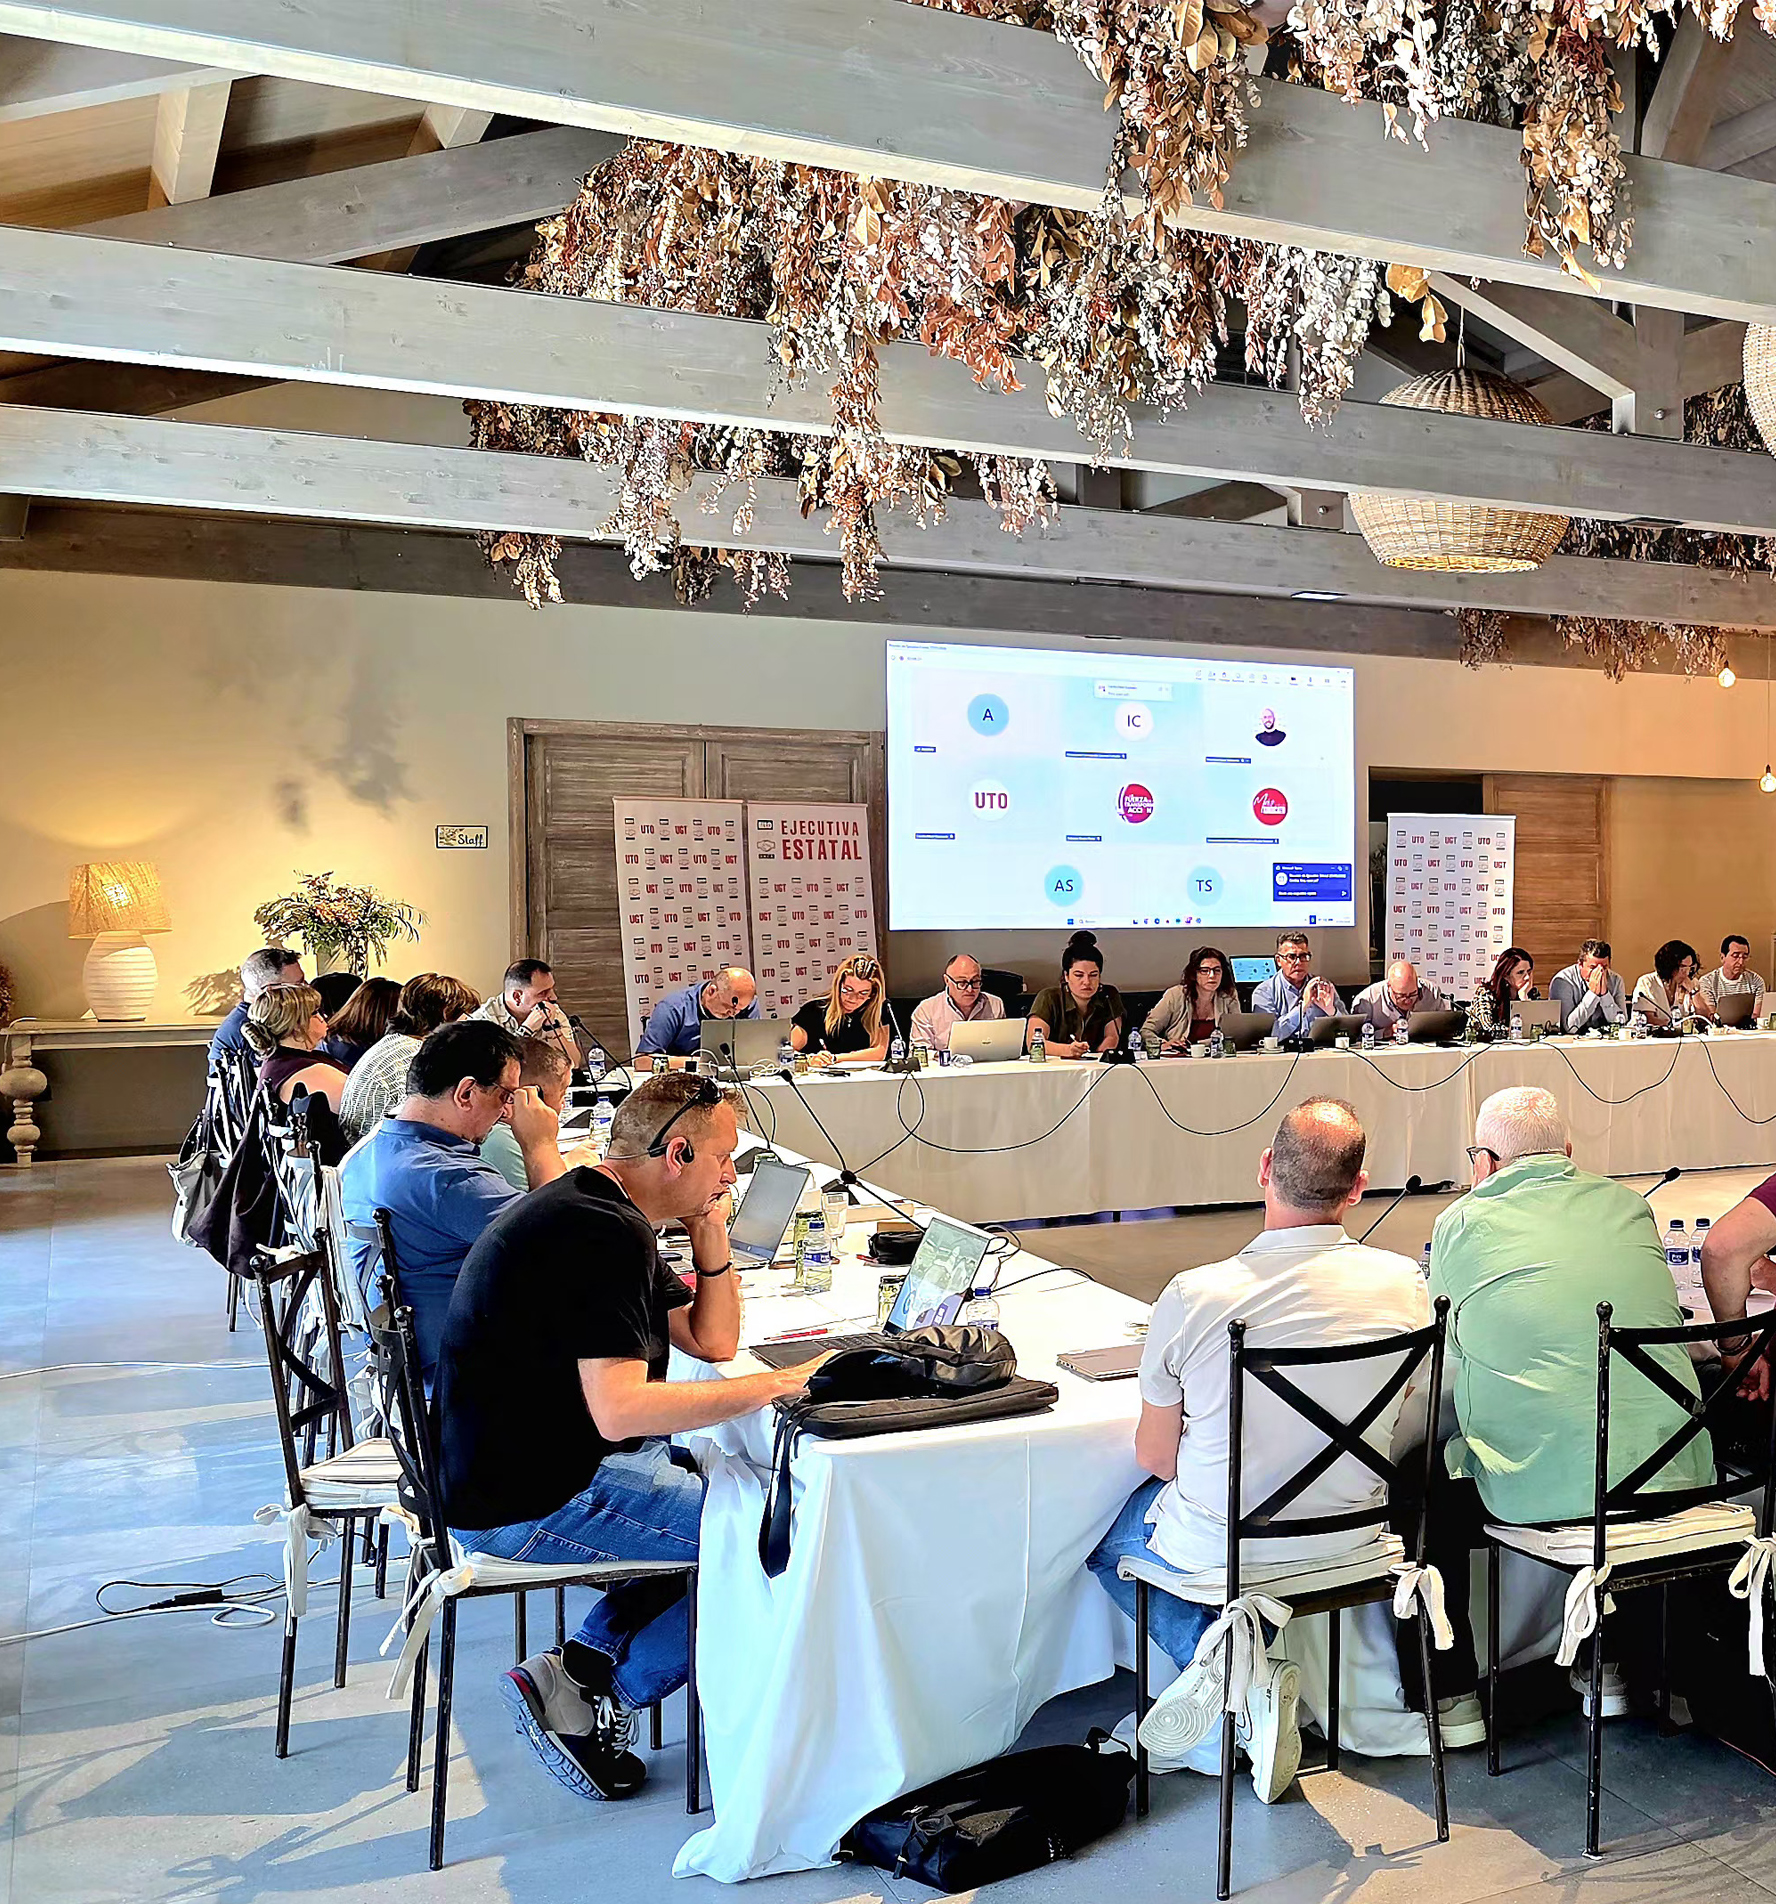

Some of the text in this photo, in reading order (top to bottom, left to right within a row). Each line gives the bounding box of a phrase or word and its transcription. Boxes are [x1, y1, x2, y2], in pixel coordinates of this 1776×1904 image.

[982, 709, 994, 722] A
[1127, 715, 1141, 728] IC
[975, 793, 1007, 810] UTO
[641, 825, 721, 835] UTO UGT UTO
[781, 820, 860, 836] EJECUTIVA
[457, 833, 485, 847] Staff
[1411, 836, 1491, 845] UTO UGT UTO
[782, 839, 863, 860] ESTATAL
[625, 854, 737, 864] UTO UGT UTO UGT
[1394, 859, 1507, 869] UTO UGT UTO UGT
[646, 884, 658, 893] UGT
[679, 883, 693, 893] UTO
[774, 883, 849, 893] UGT UTO UGT
[1054, 880, 1074, 893] AS
[1195, 880, 1213, 893] TS
[1411, 882, 1489, 892] UGT UTO UGT
[759, 912, 772, 921] UGT
[792, 911, 805, 920] UTO
[854, 910, 867, 919] UTO
[1393, 905, 1407, 914] UGT
[1427, 905, 1440, 914] UTO
[1459, 906, 1472, 915] UGT
[629, 912, 741, 924] UGT UTO UGT UTO
[1410, 929, 1488, 938] UTO UGT UTO
[650, 941, 730, 953] UTO UGT UTO
[777, 937, 852, 948] UTO UGT UTO
[1392, 952, 1406, 960] UTO
[1426, 952, 1439, 961] UGT
[1458, 953, 1471, 961] UTO
[762, 968, 775, 977] UTO
[795, 967, 807, 976] UGT
[635, 974, 649, 984] UTO
[669, 972, 682, 981] UGT
[781, 996, 793, 1004] UGT
